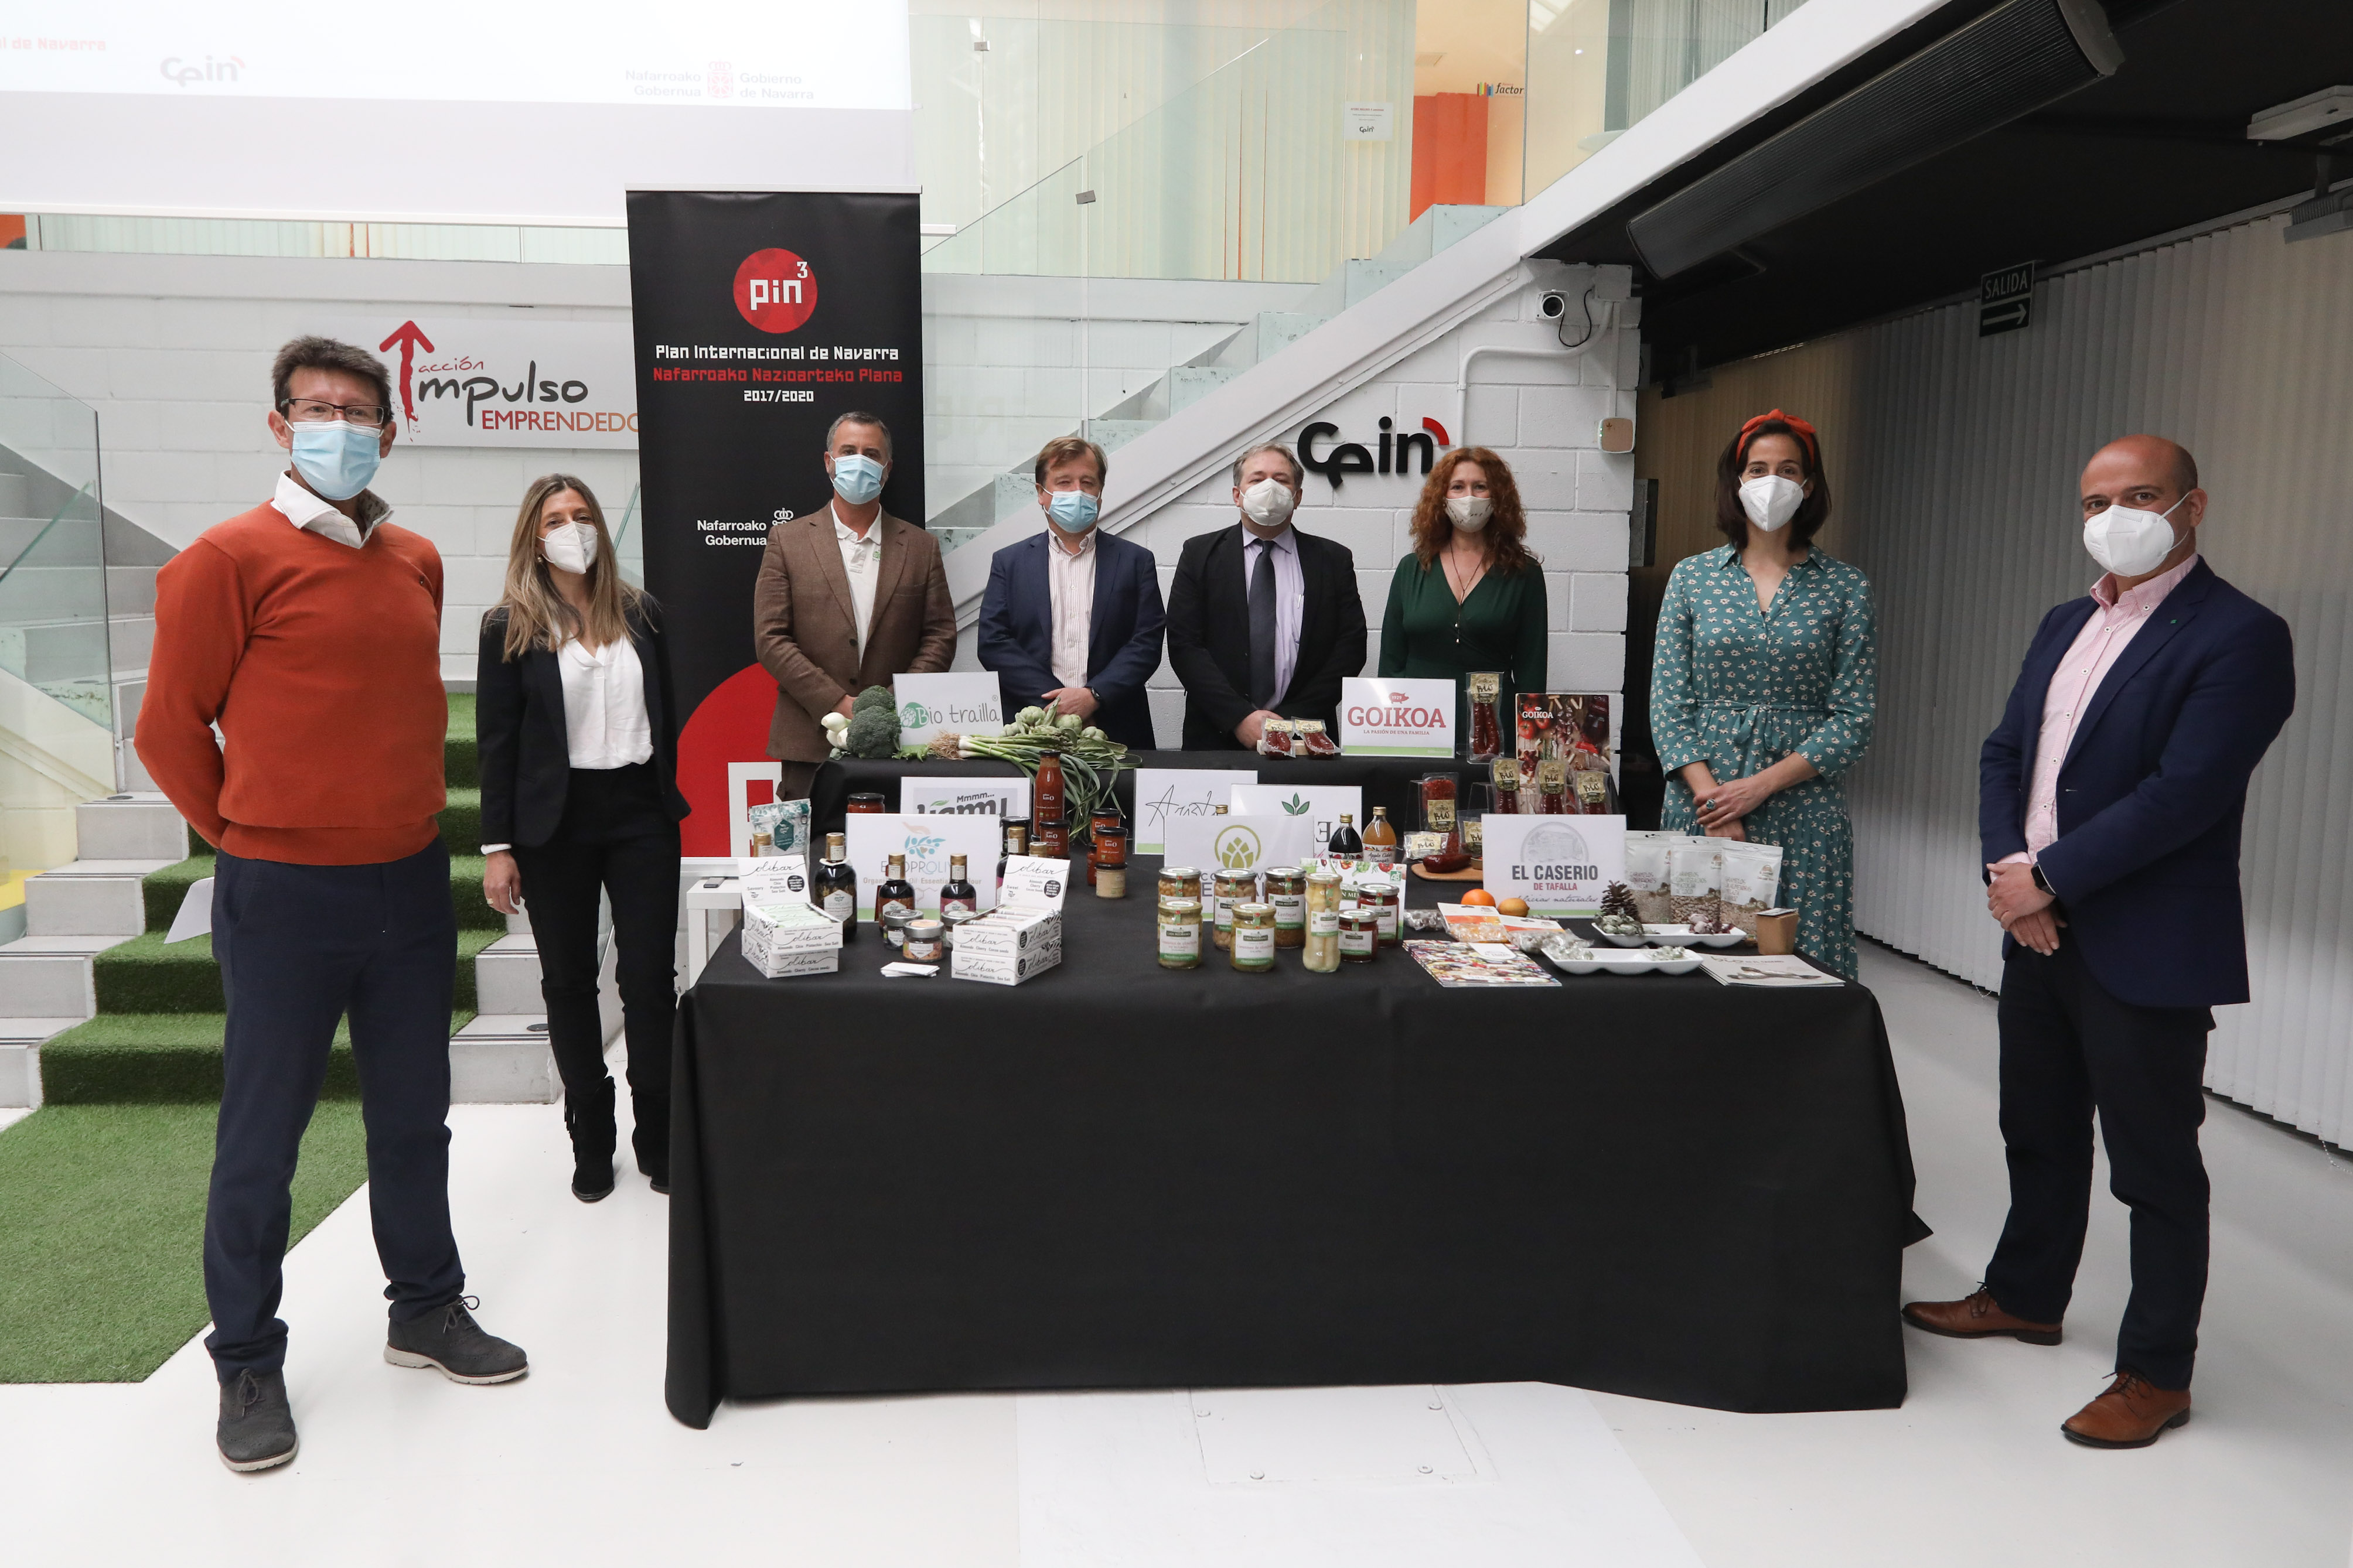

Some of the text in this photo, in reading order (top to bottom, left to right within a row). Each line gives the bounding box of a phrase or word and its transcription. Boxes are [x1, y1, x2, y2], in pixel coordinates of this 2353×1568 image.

[12, 38, 32, 50] de
[38, 38, 106, 51] Navarra
[625, 69, 701, 82] Nafarroako
[739, 73, 802, 84] Gobierno
[634, 86, 701, 97] Gobernua
[740, 88, 814, 99] de Navarra
[1495, 83, 1524, 94] factor
[1985, 270, 2028, 299] SALIDA
[656, 345, 899, 360] Plan Internacional de Navarra
[418, 356, 483, 373] acción
[653, 367, 902, 382] Nafarroako Nazioarteko Plana
[744, 390, 814, 402] 2017/2020
[697, 520, 767, 531] Nafarroako
[705, 534, 767, 546] Gobernua
[916, 703, 1000, 725] Bio trailla
[1348, 706, 1446, 728] GOIKOA
[957, 792, 995, 803] Mmmm...
[1019, 862, 1055, 874] olibar
[1512, 865, 1598, 880] EL CASERIO
[1553, 894, 1598, 903] naturales
